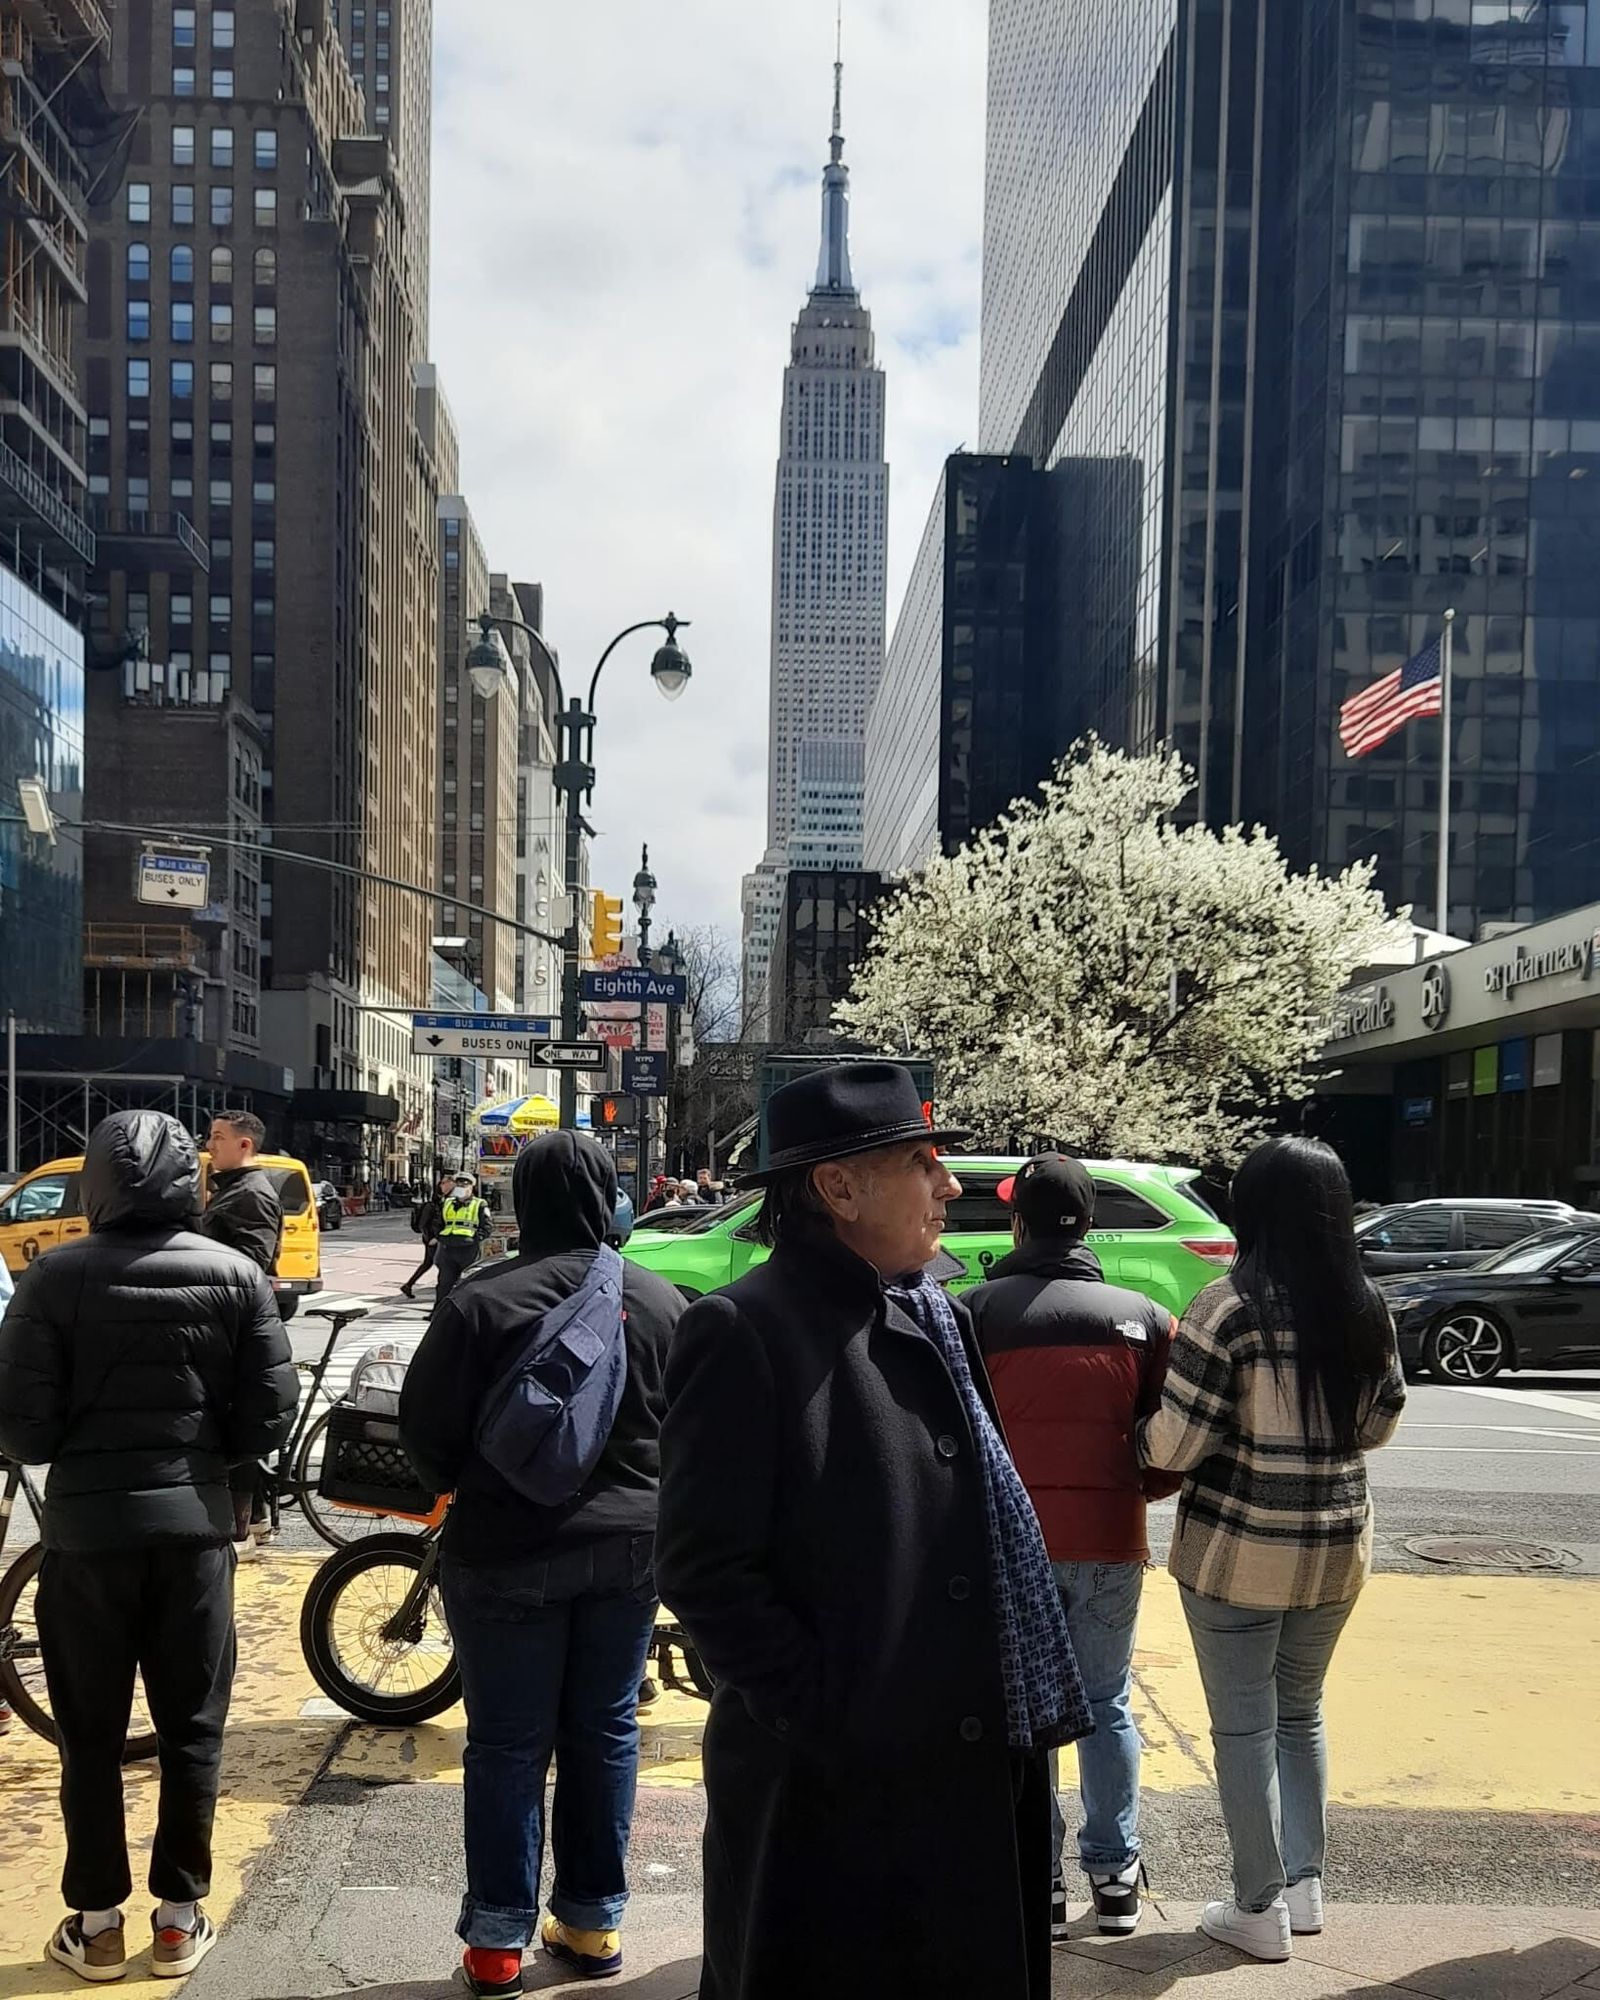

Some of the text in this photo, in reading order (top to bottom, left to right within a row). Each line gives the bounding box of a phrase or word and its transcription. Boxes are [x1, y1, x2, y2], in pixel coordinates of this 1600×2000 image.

[158, 860, 204, 873] BUS LANE
[145, 872, 203, 887] BUSES ONLY
[1502, 936, 1593, 1001] pharmacy
[594, 977, 675, 996] Eighth Ave
[1421, 976, 1446, 1019] DR
[454, 1017, 509, 1031] BUS LANE
[461, 1037, 530, 1052] BUSES ONL
[543, 1049, 593, 1060] ONE WAY
[635, 1055, 655, 1063] NYPD
[631, 1074, 658, 1083] Security
[631, 1081, 657, 1089] Camera
[1086, 1233, 1123, 1243] 8097
